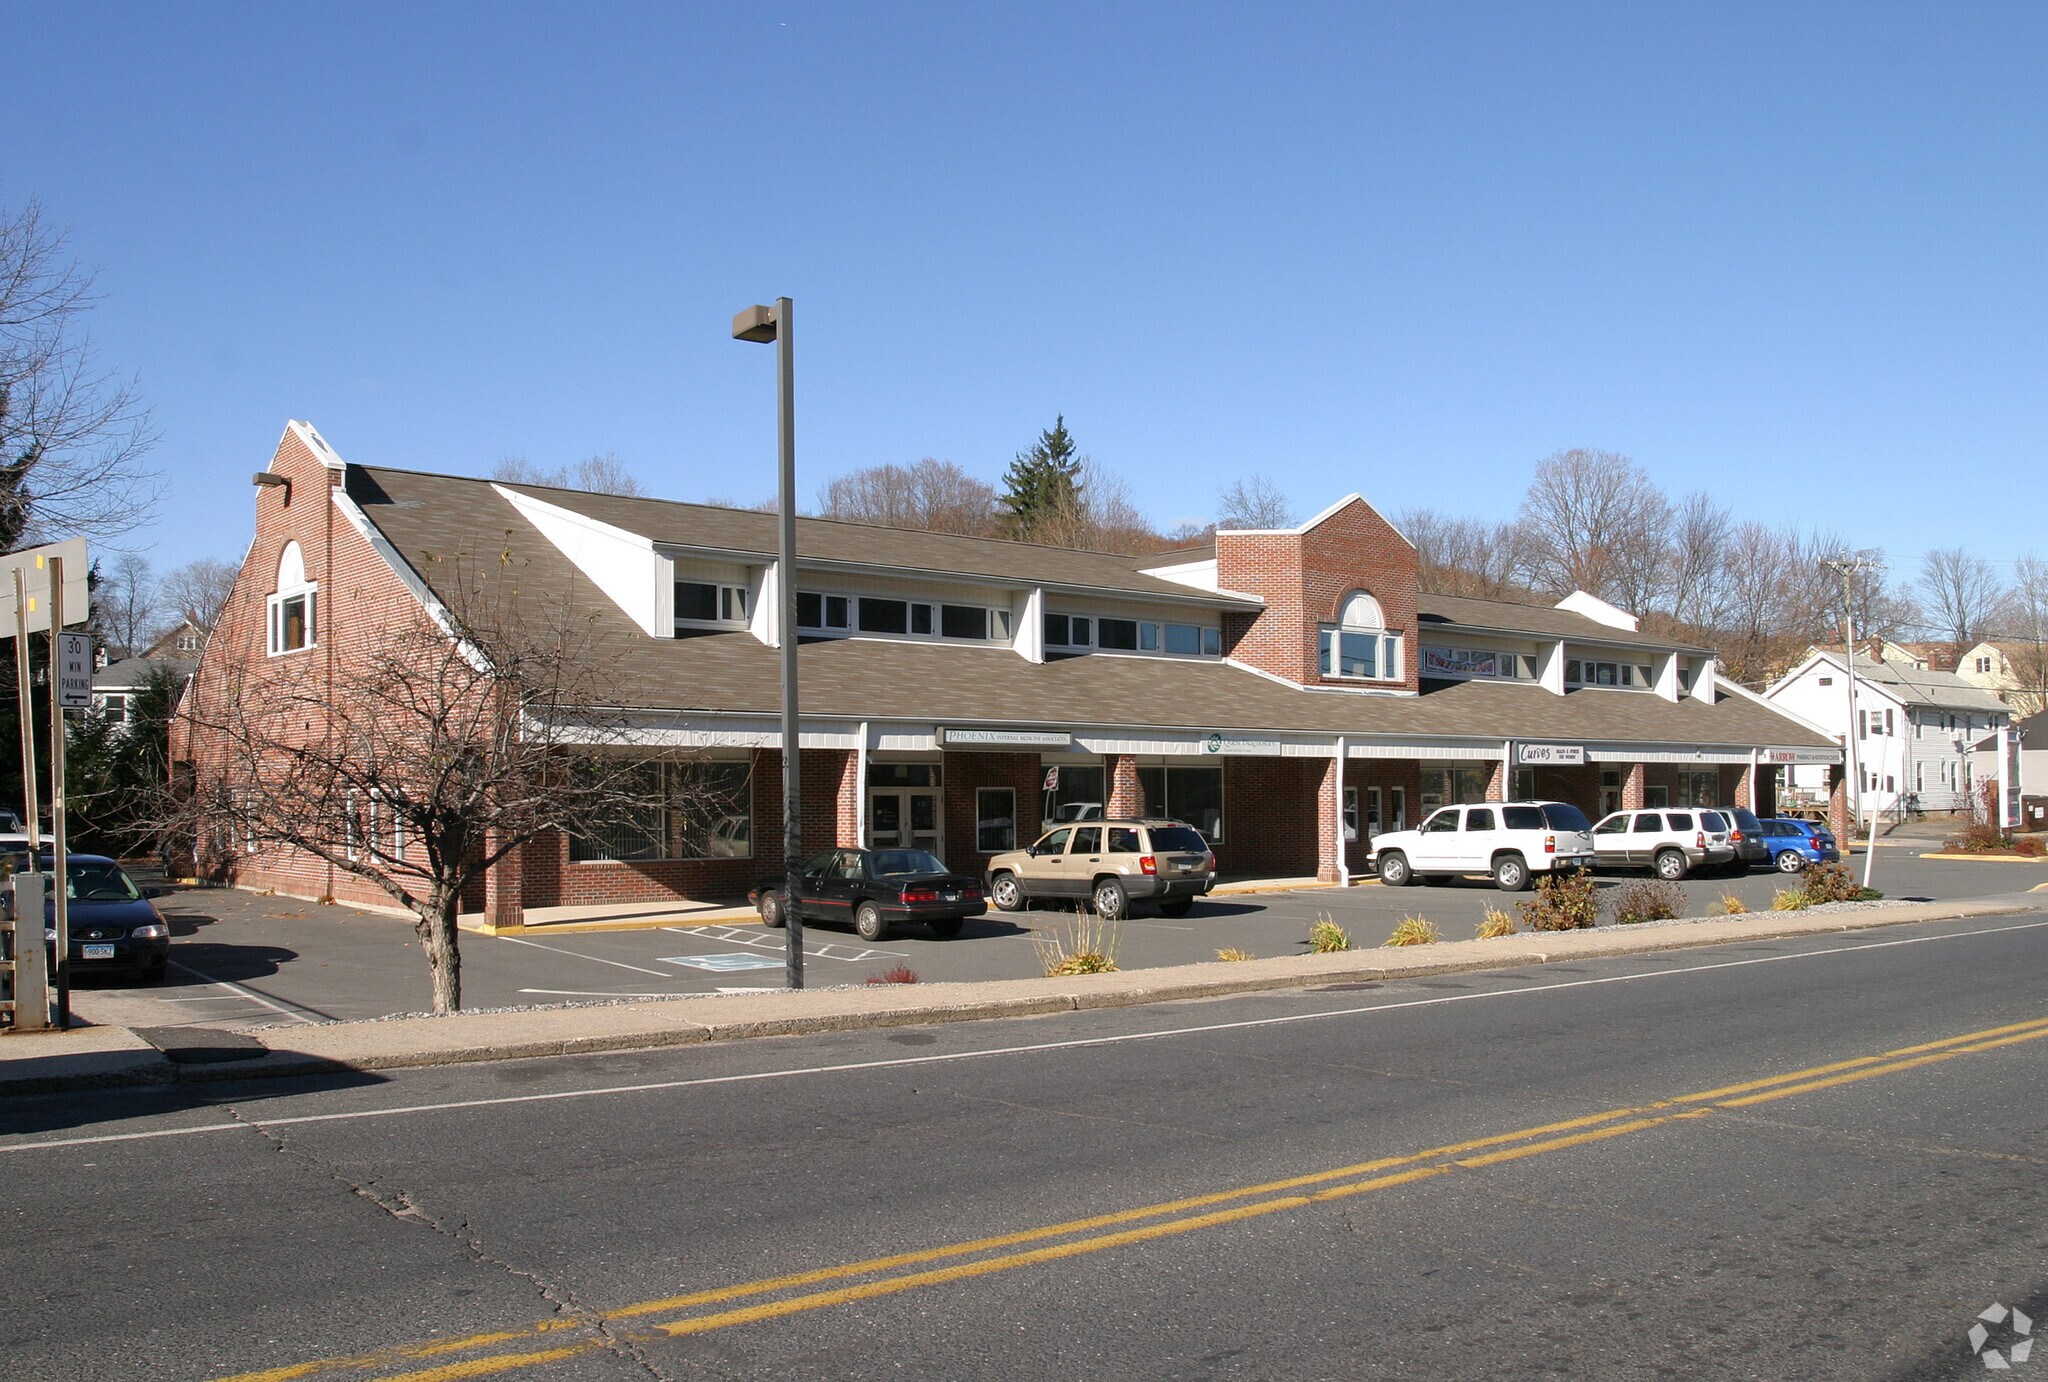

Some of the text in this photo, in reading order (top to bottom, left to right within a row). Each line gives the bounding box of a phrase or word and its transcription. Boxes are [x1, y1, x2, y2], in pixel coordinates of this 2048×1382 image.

[68, 640, 82, 655] 30
[69, 661, 82, 673] MIN
[61, 677, 89, 690] PARKING
[949, 730, 996, 741] PHOENIX
[1520, 744, 1551, 761] Curves
[1775, 752, 1796, 761] ARROW
